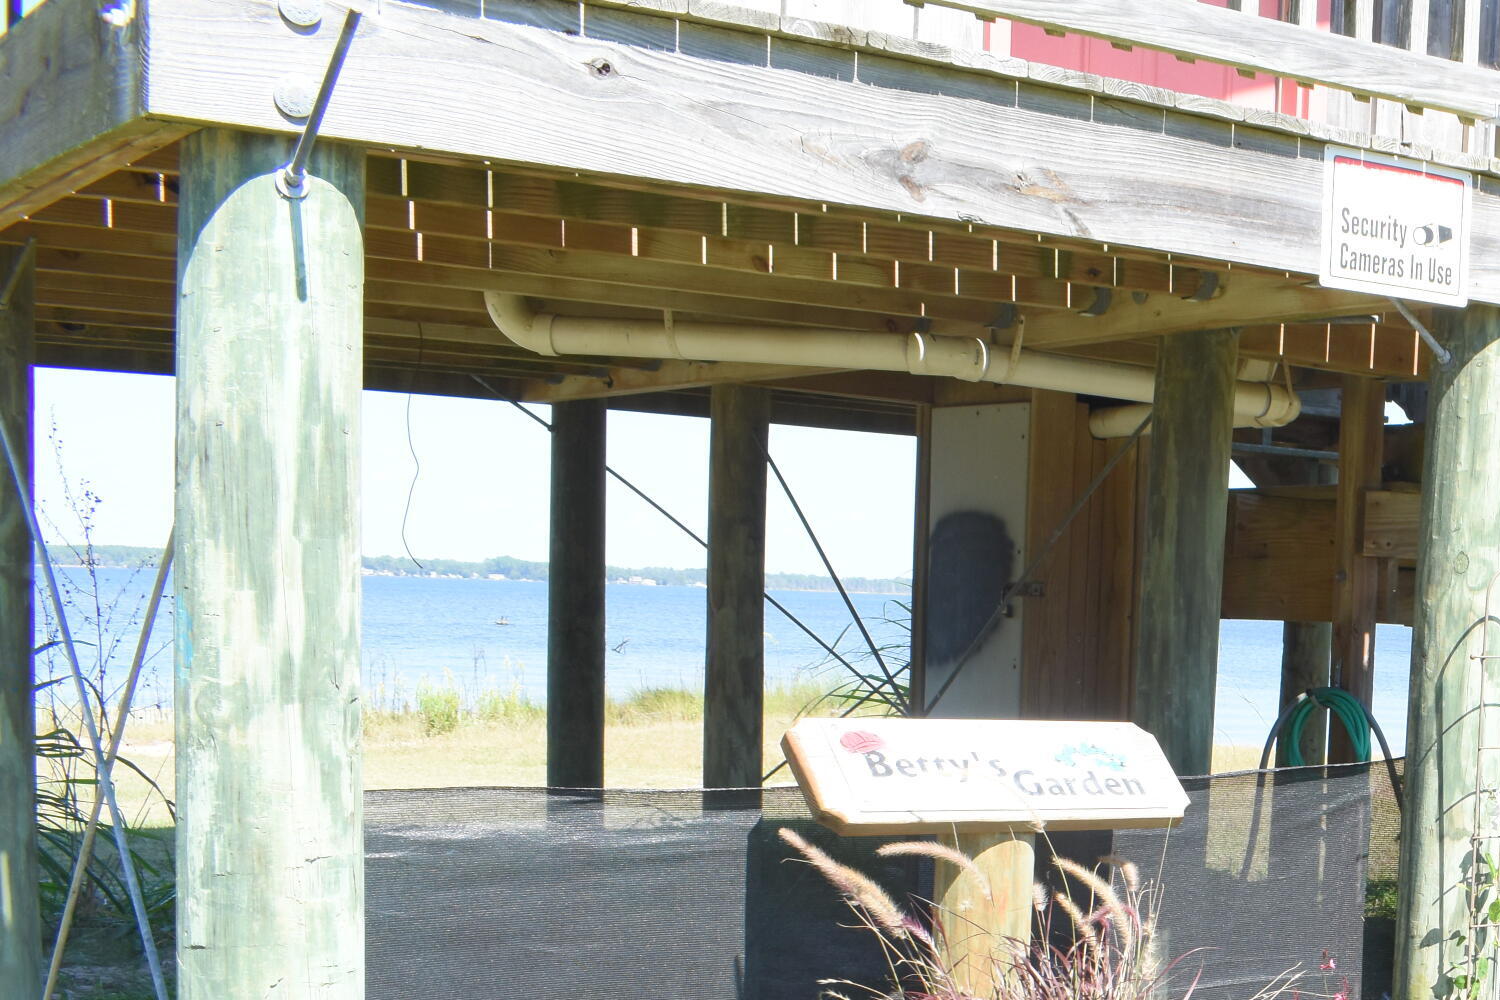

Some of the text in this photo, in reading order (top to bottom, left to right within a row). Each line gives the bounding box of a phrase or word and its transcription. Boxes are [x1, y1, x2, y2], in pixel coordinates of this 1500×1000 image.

[1341, 207, 1408, 249] Security
[1340, 242, 1453, 286] Cameras In Use
[864, 750, 1008, 783] Berry's
[1013, 770, 1146, 797] Garden
